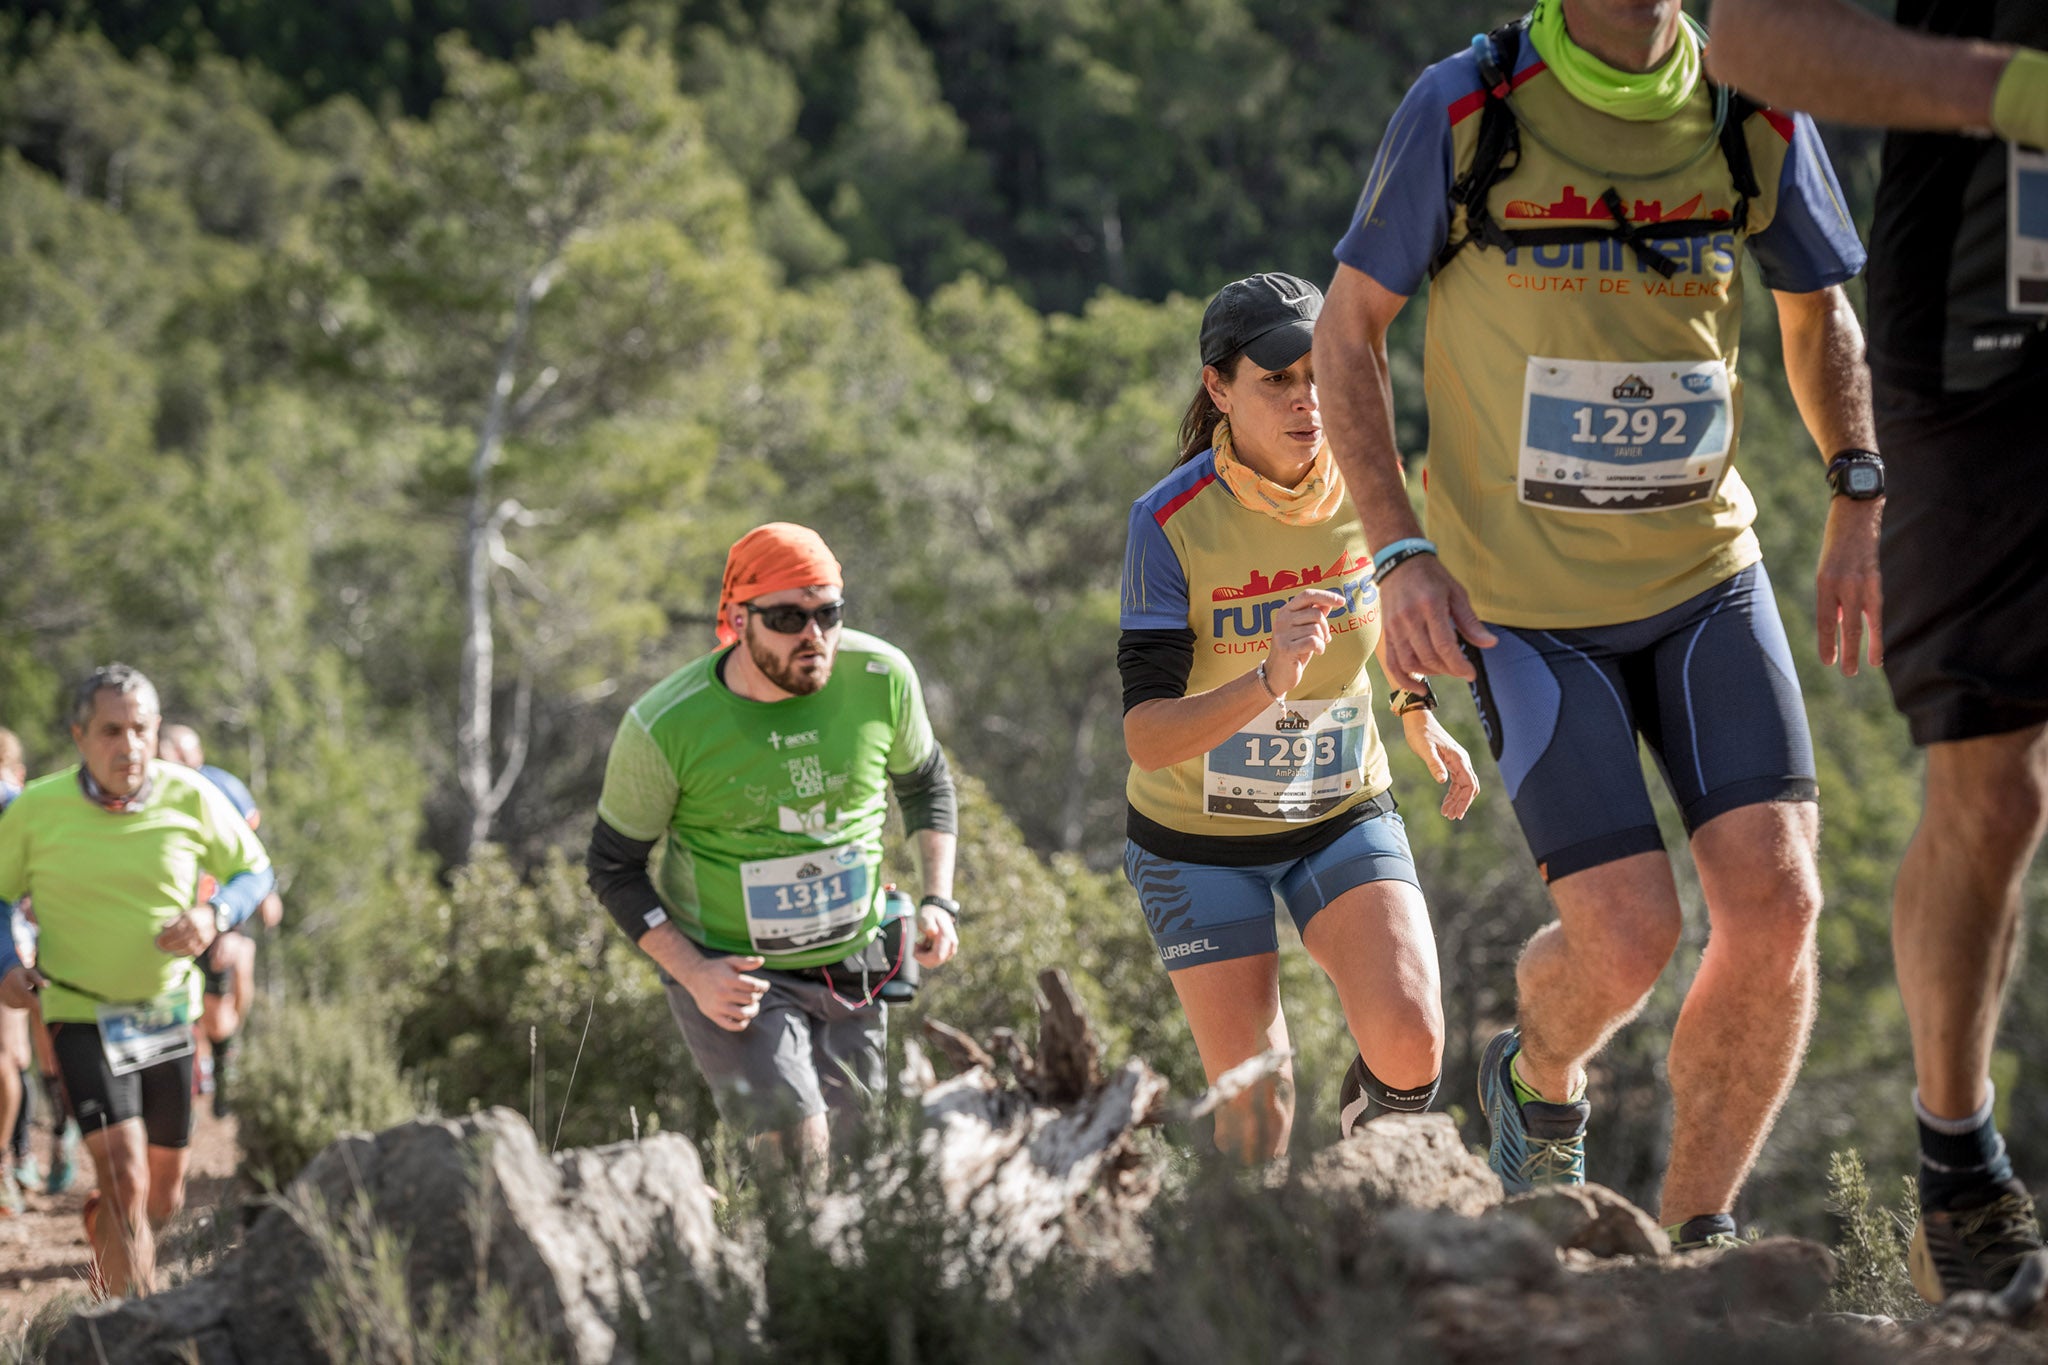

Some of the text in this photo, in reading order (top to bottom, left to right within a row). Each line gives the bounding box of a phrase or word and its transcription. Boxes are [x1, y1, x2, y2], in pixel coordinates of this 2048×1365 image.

[1507, 273, 1589, 293] CIUTAT
[1599, 278, 1632, 295] DE
[1571, 407, 1688, 445] 1292
[1614, 447, 1643, 458] JAVIER
[1213, 574, 1378, 639] runers
[1336, 709, 1353, 720] 15K
[1245, 736, 1337, 768] 1293
[774, 875, 847, 911] 1311
